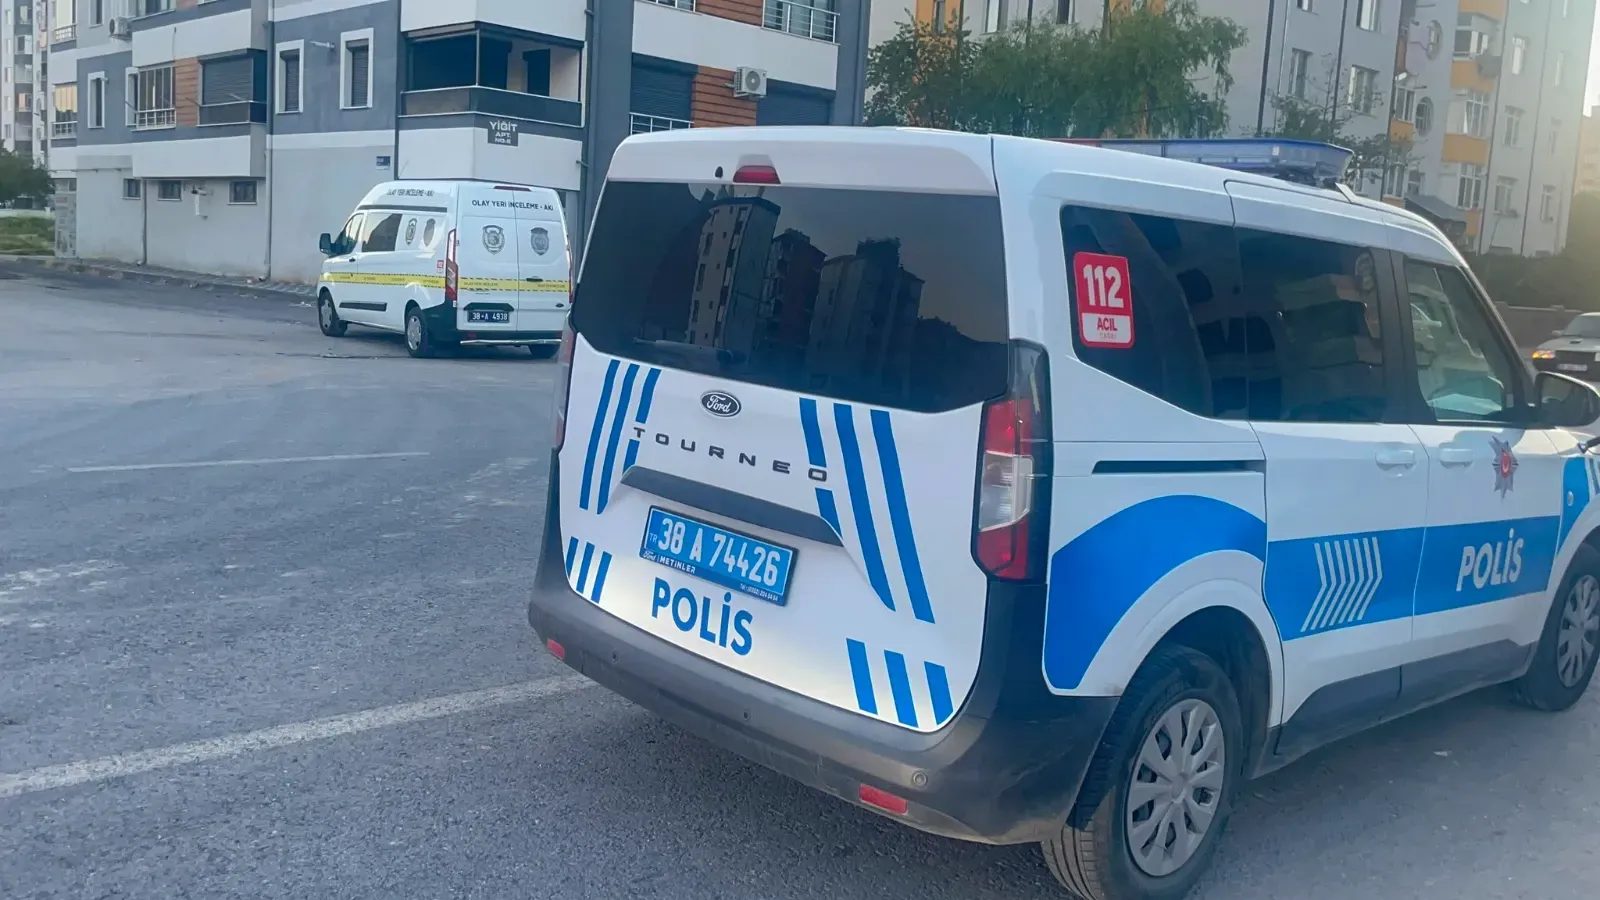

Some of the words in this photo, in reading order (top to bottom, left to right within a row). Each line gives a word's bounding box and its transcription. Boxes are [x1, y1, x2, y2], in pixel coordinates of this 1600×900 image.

[489, 120, 518, 132] YİĞİT
[1083, 264, 1124, 308] 112
[472, 312, 481, 320] 38
[492, 312, 508, 320] 4938
[706, 394, 731, 413] Ford
[633, 426, 828, 483] TOURNEO
[650, 532, 658, 543] TR
[657, 517, 686, 555] 38
[689, 528, 703, 562] A
[709, 533, 781, 587] 74426
[1455, 527, 1525, 592] POLİS
[651, 576, 754, 656] POLİS
